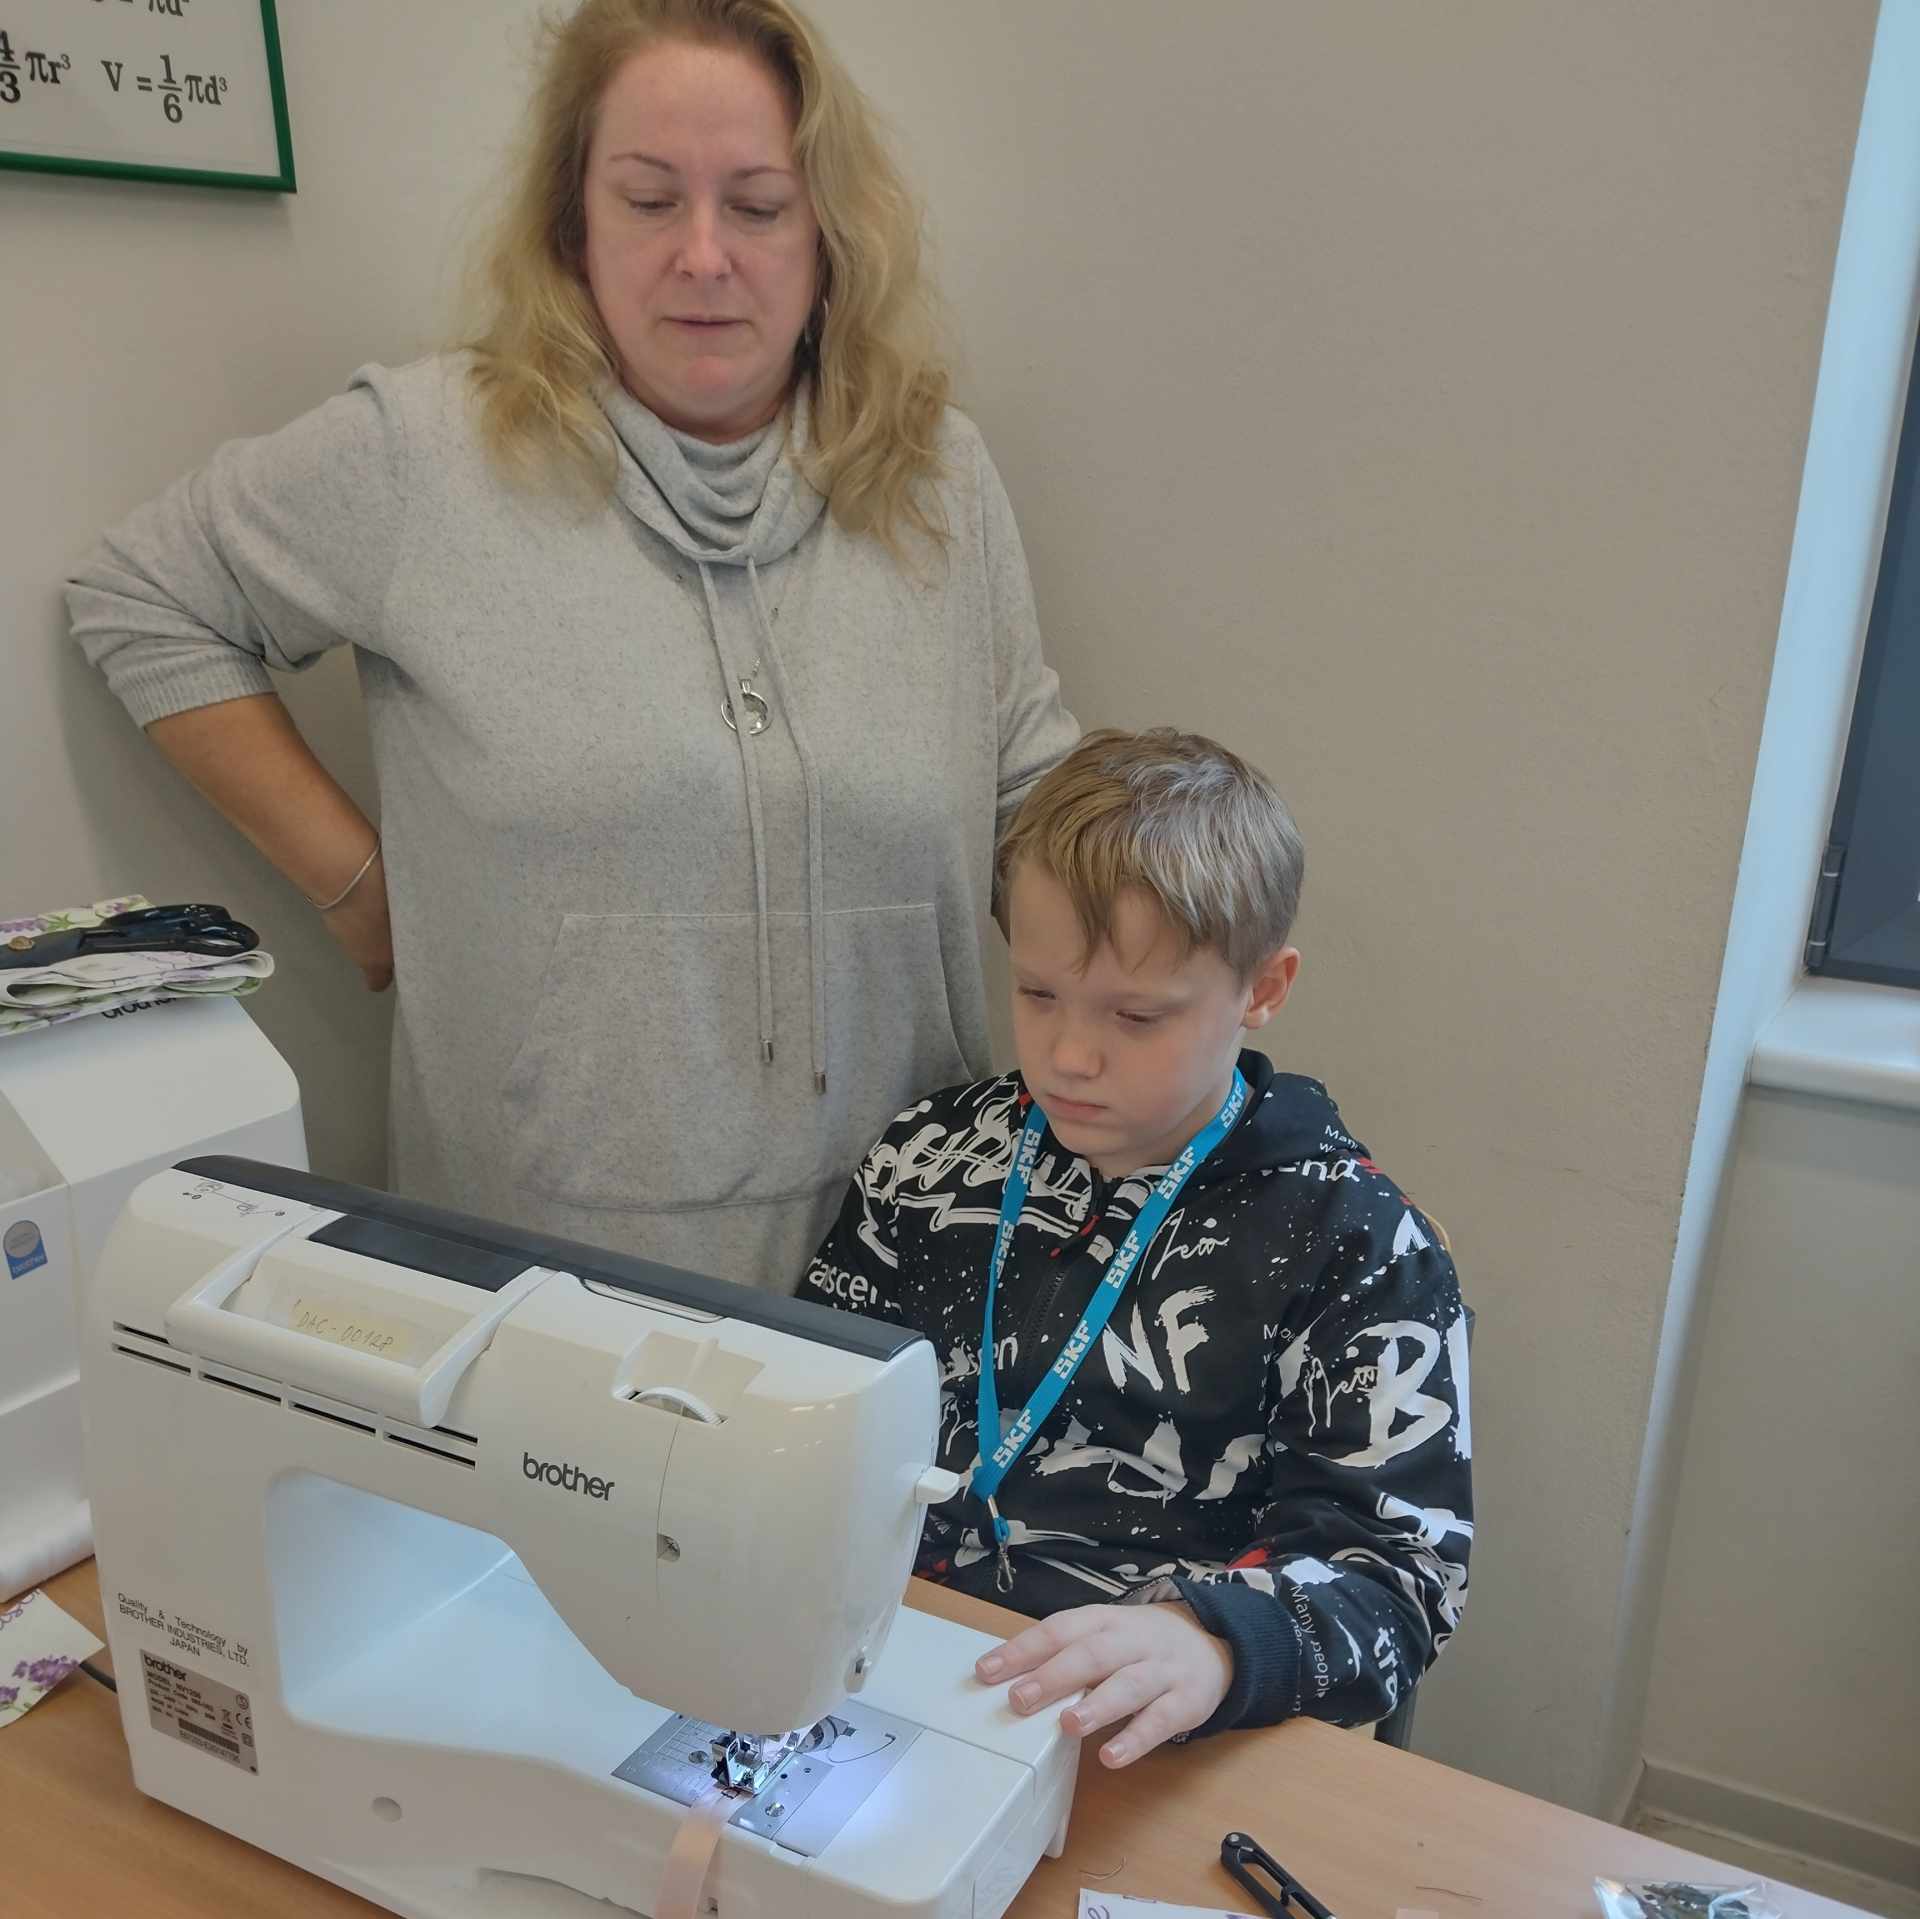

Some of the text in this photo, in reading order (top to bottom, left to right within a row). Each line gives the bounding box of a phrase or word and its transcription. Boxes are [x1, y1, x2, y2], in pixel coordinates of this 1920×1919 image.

[1157, 1146, 1194, 1199] SKF
[1104, 1229, 1140, 1289] SKF
[1053, 1319, 1092, 1379] SKF
[992, 1408, 1033, 1469] SKF
[523, 1452, 615, 1501] brother
[119, 1603, 165, 1631] BROTHER
[175, 1615, 226, 1647] Technology
[1290, 1583, 1317, 1634] Many
[143, 1653, 187, 1681] brother
[169, 1637, 201, 1657] JAPAN
